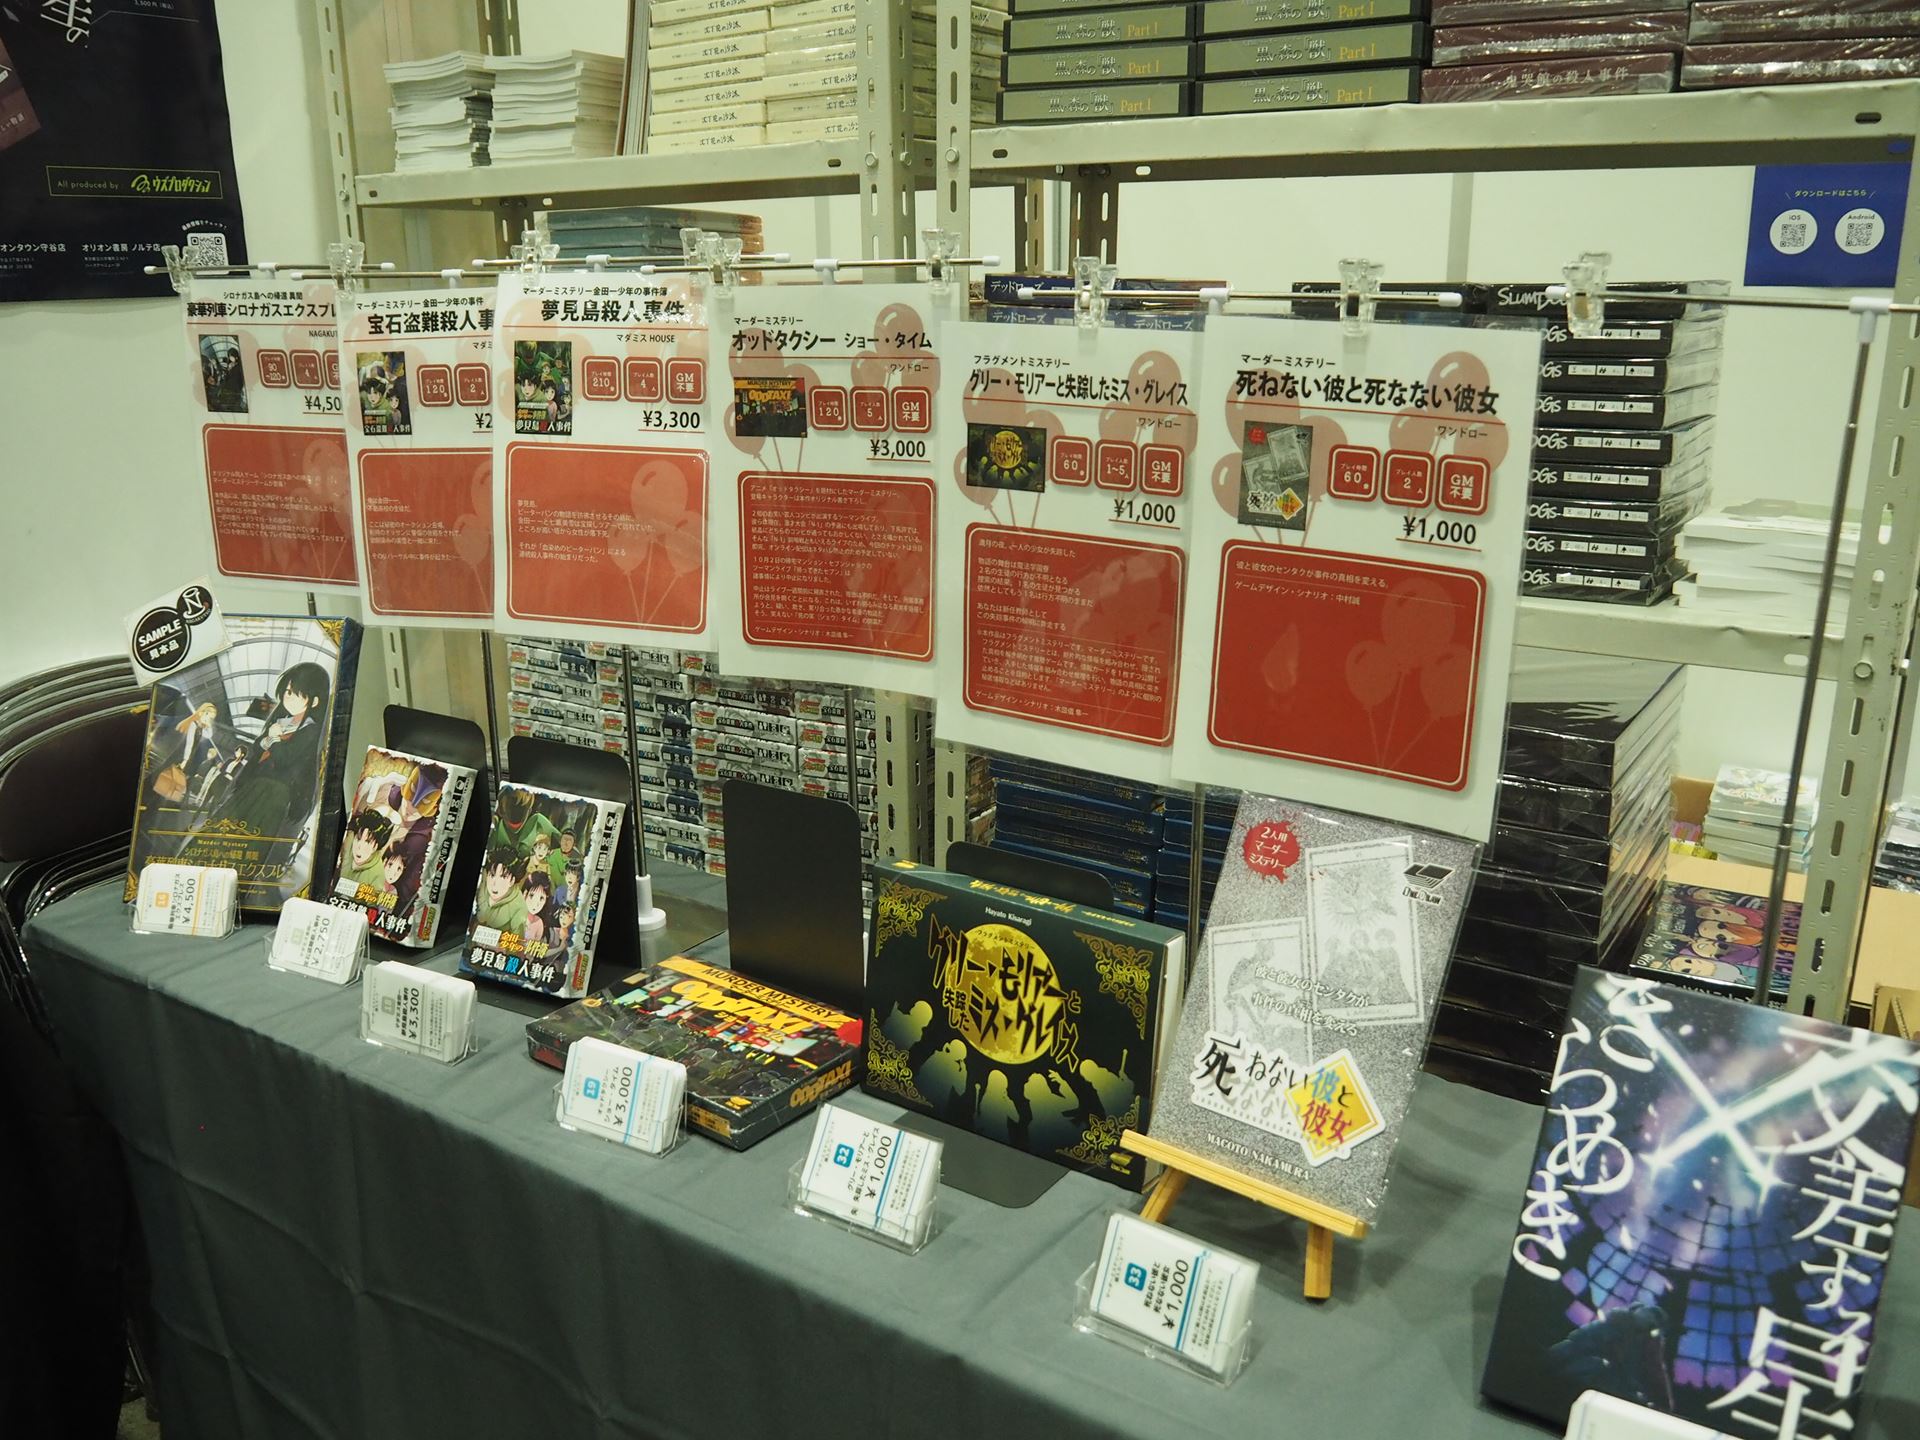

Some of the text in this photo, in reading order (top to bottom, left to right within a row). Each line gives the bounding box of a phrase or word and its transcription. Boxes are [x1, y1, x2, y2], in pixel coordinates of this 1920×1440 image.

[1339, 4, 1365, 18] Part
[1128, 24, 1150, 37] Part
[1340, 47, 1366, 60] Part
[1128, 62, 1151, 75] Part
[1337, 89, 1363, 102] Part
[1121, 99, 1143, 112] Part
[71, 181, 107, 190] produced
[110, 181, 119, 191] by
[1794, 189, 1867, 198] ダウンロードはこちら
[541, 299, 685, 323] 夢見島殺人事件
[734, 316, 804, 326] マーダーミステリー
[649, 334, 675, 343] HOUSE
[732, 329, 933, 351] オッドタクシー ショー・タイム
[890, 363, 929, 372] ワンドロー
[973, 355, 1070, 369] フラグメントミステリー
[1241, 354, 1336, 368] マーダーミステリー
[676, 373, 694, 382] GM
[676, 383, 695, 393] 不要
[1236, 370, 1500, 416] 死ねない彼と死なない彼女
[902, 402, 920, 411] GM
[643, 411, 700, 430] ¥3,300
[902, 412, 920, 422] 不要
[1138, 417, 1181, 429] ワンドロー
[1437, 425, 1488, 438] ワンドロー
[871, 439, 926, 459] ¥3,000
[1152, 461, 1171, 472] GM
[1152, 472, 1171, 484] 不要
[1451, 474, 1474, 487] GM
[1450, 488, 1473, 500] 不要
[1114, 499, 1176, 523] ¥1,000
[1403, 516, 1477, 544] ¥1,000
[138, 618, 183, 648] SAMPLE
[149, 640, 180, 661] 見本品
[1260, 826, 1288, 843] 2人用
[1255, 840, 1289, 856] マーダー
[1248, 854, 1286, 870] ミステリー
[182, 878, 196, 924] ¥4,500
[985, 906, 1032, 926] Hayato Kisaragi
[311, 917, 331, 966] ¥2,750
[470, 947, 555, 983] 夢見島殺人事件
[703, 967, 838, 1019] MURDER MYSTERY
[409, 988, 420, 1040] ¥3,300
[613, 1067, 633, 1127] ¥3,000
[1300, 1100, 1355, 1144] 彼女
[837, 1147, 850, 1165] 32
[865, 1135, 893, 1200] ¥1,000
[1251, 1148, 1311, 1182] NAKAMURA
[1128, 1265, 1143, 1288] 33
[1162, 1259, 1190, 1330] ¥1,000
